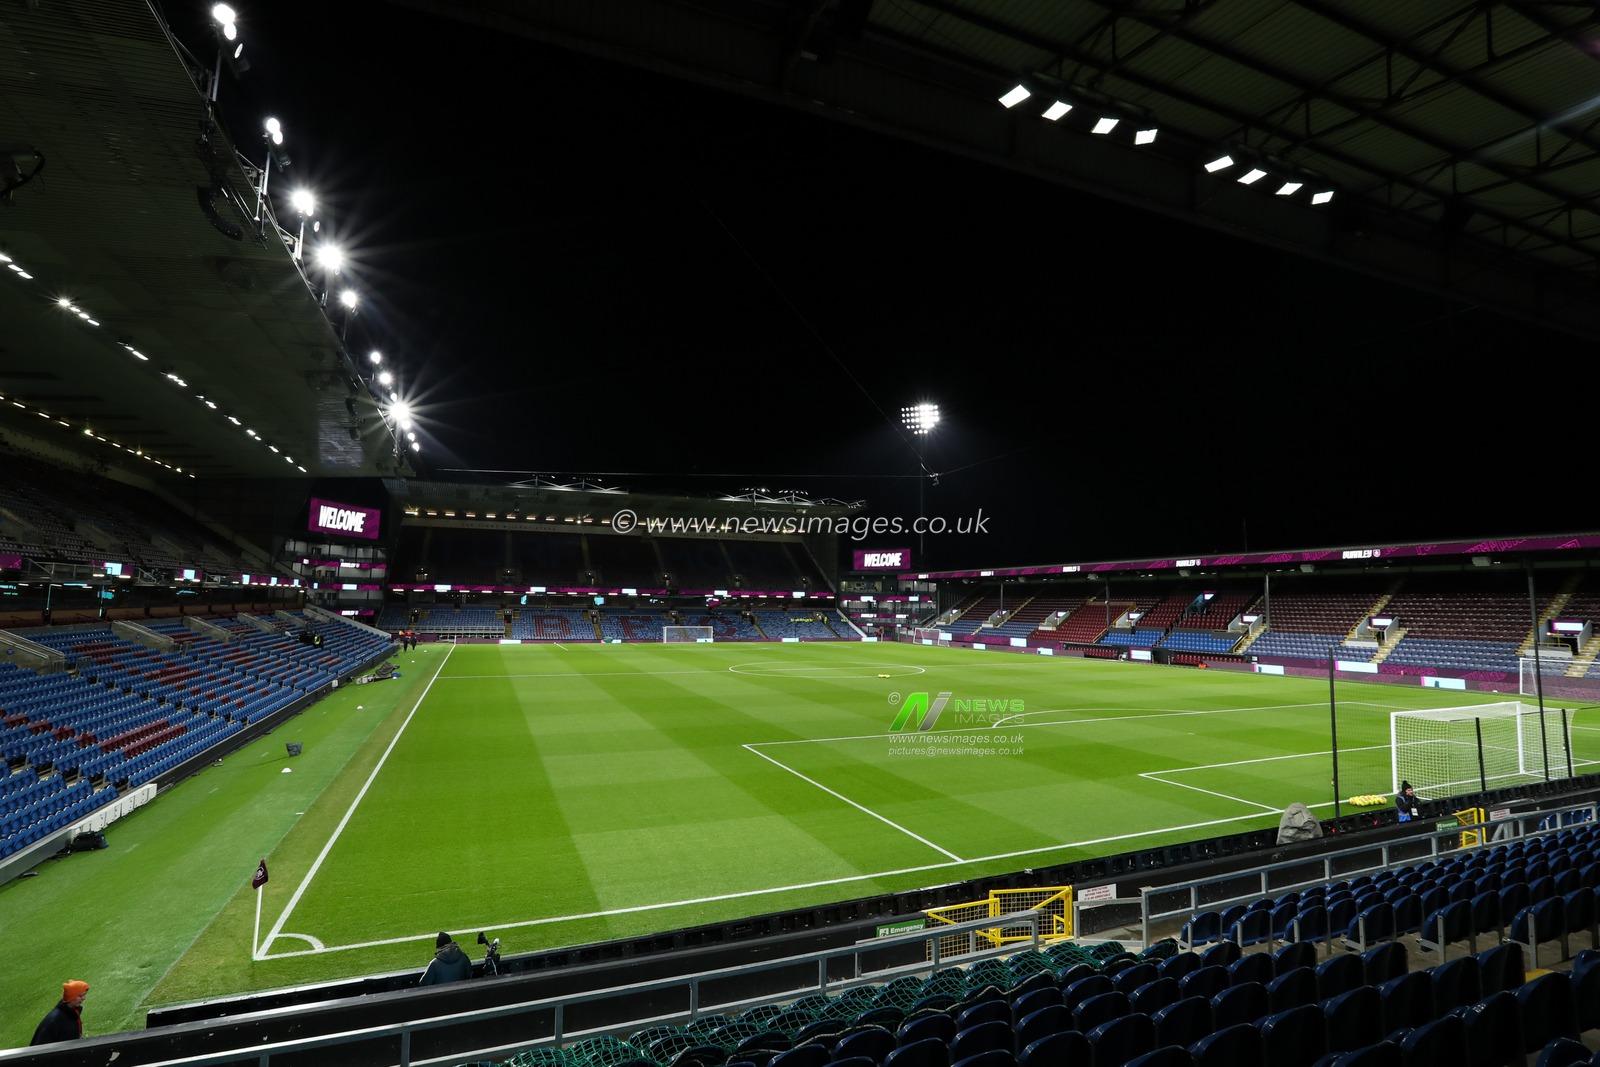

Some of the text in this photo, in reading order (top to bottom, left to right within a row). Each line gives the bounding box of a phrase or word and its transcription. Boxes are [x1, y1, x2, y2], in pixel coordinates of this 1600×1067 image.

[319, 505, 366, 533] WELCOME
[864, 552, 902, 567] WELCOME
[890, 924, 924, 934] Emergency
